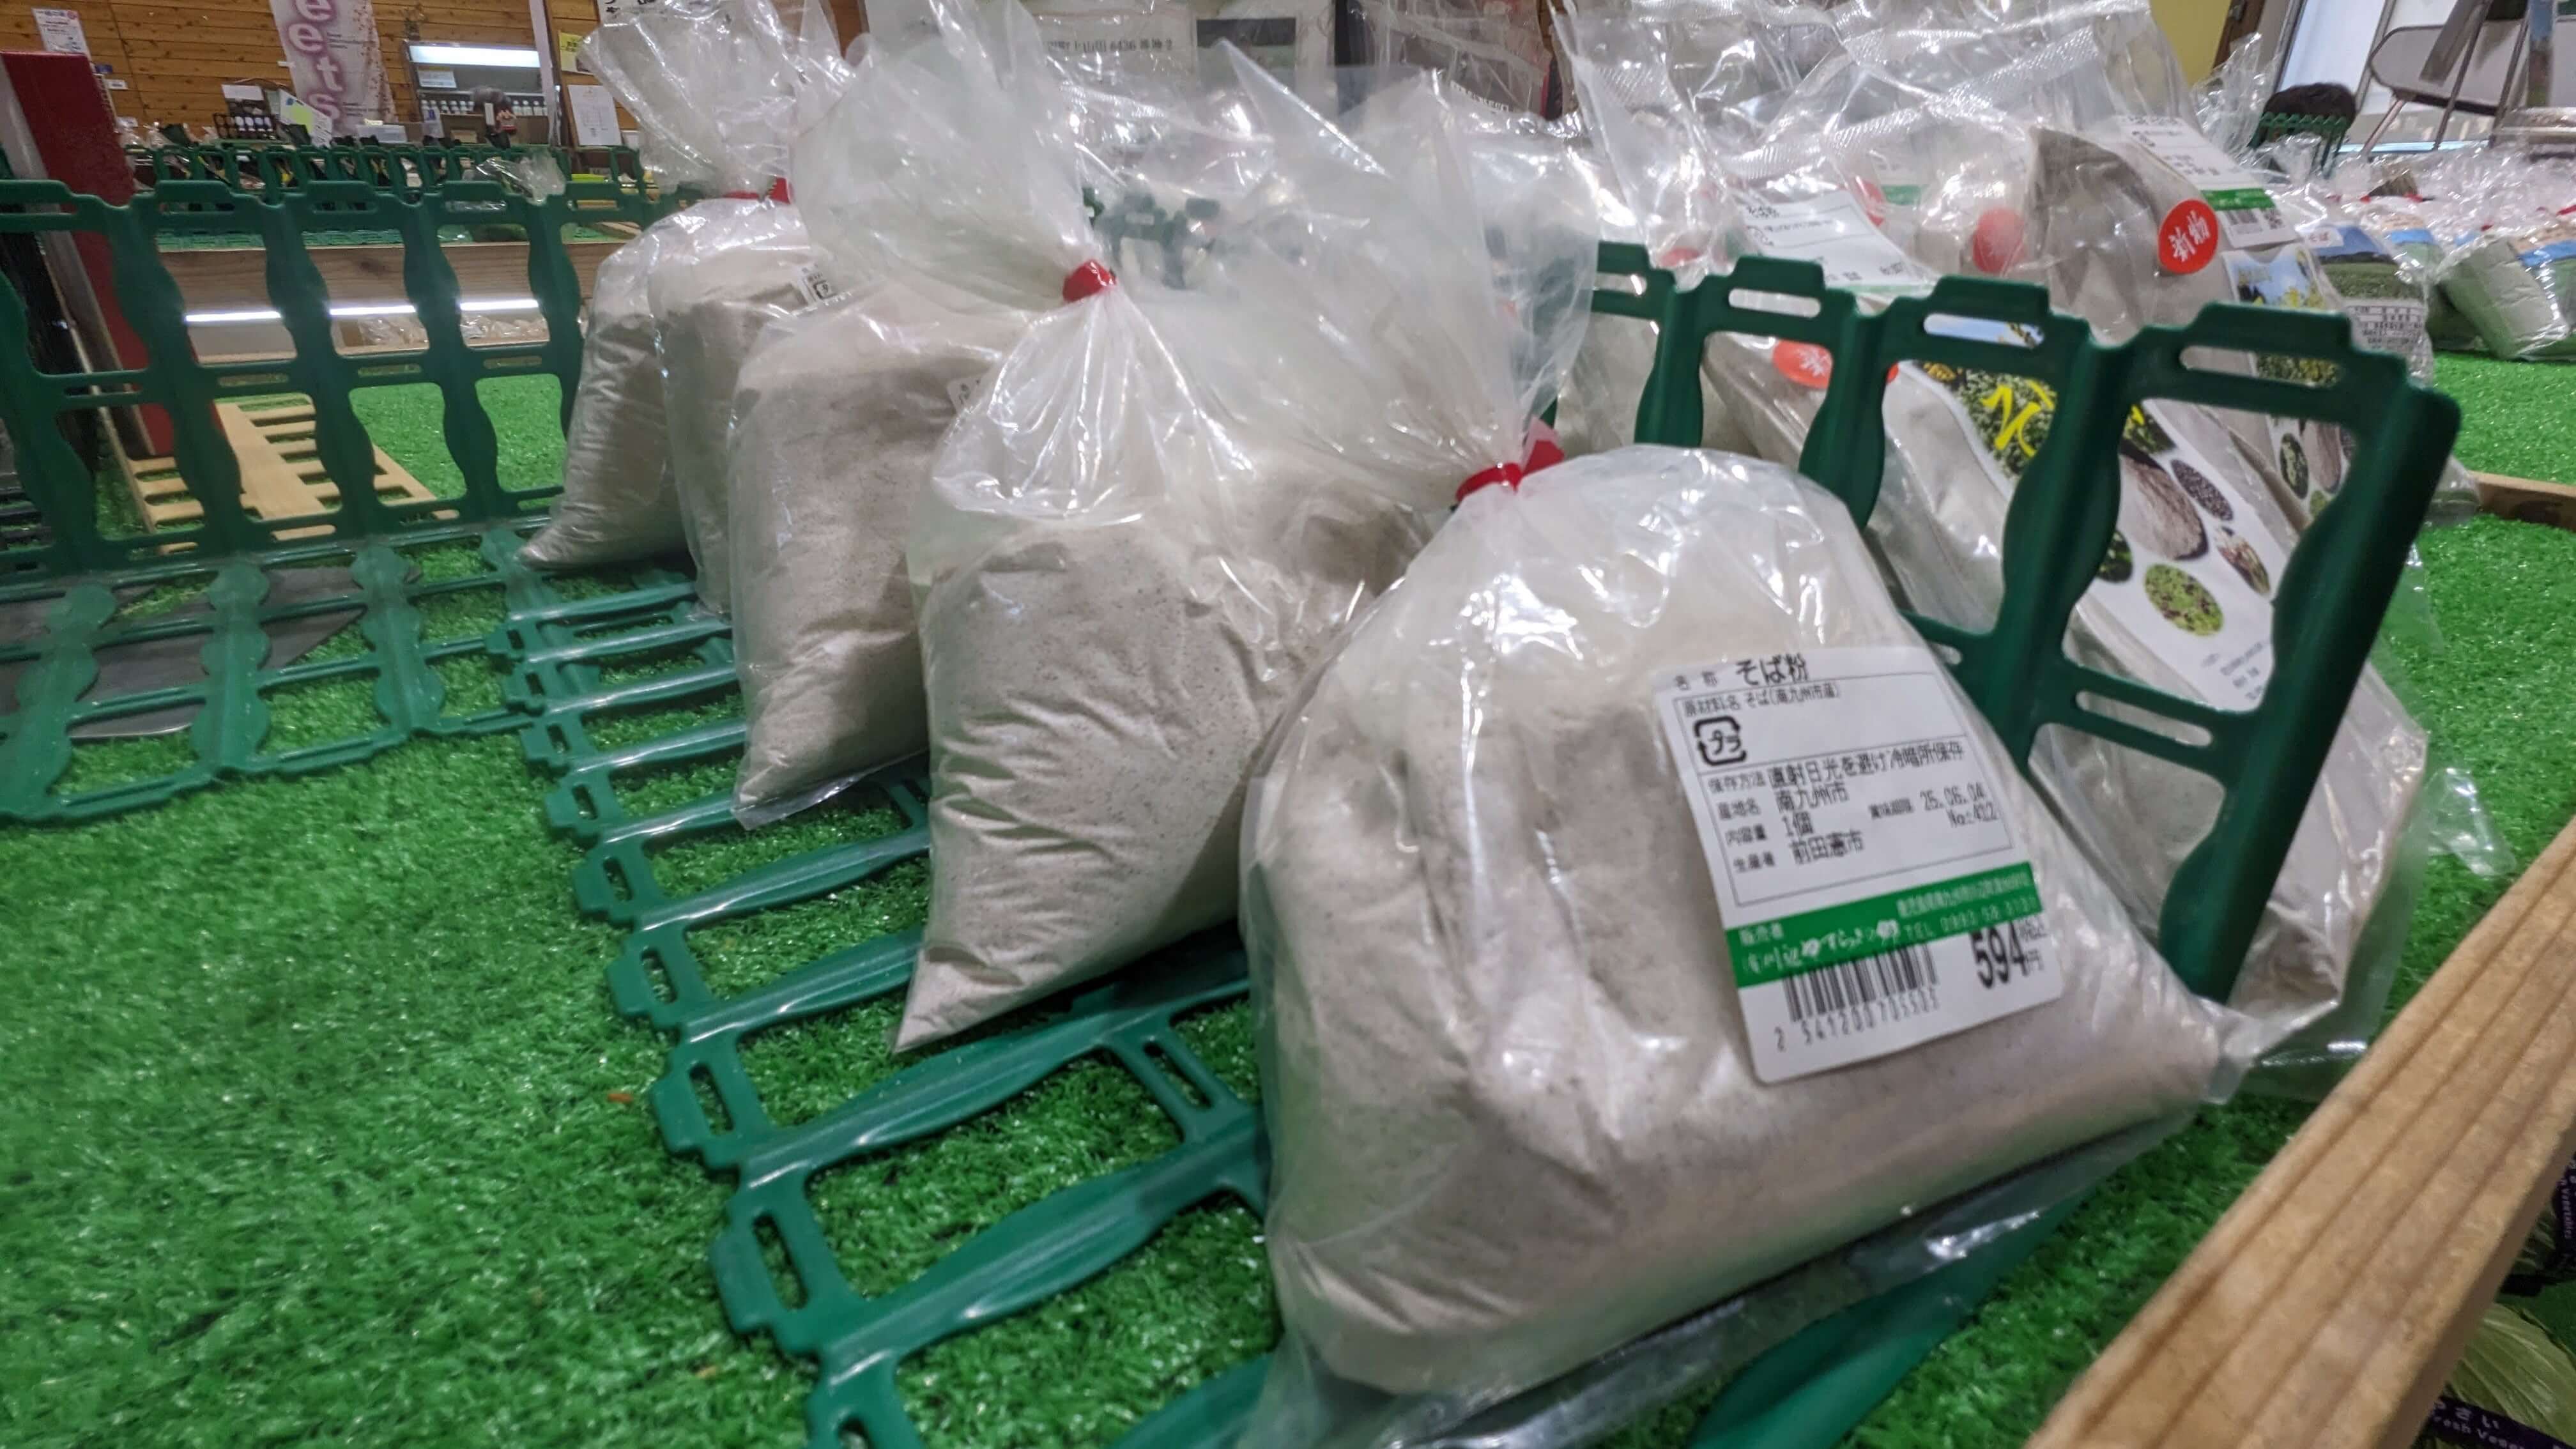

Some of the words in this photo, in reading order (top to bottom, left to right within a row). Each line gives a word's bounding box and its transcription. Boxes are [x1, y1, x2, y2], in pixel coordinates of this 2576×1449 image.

[1736, 653, 1809, 686] そば粉
[1707, 730, 1743, 755] プラ
[1707, 770, 1766, 794] 保存方法
[1775, 780, 1850, 814] 南九州市
[1725, 823, 1768, 847] 内容量
[1782, 810, 1814, 838] 1個
[1968, 921, 2029, 989] 594
